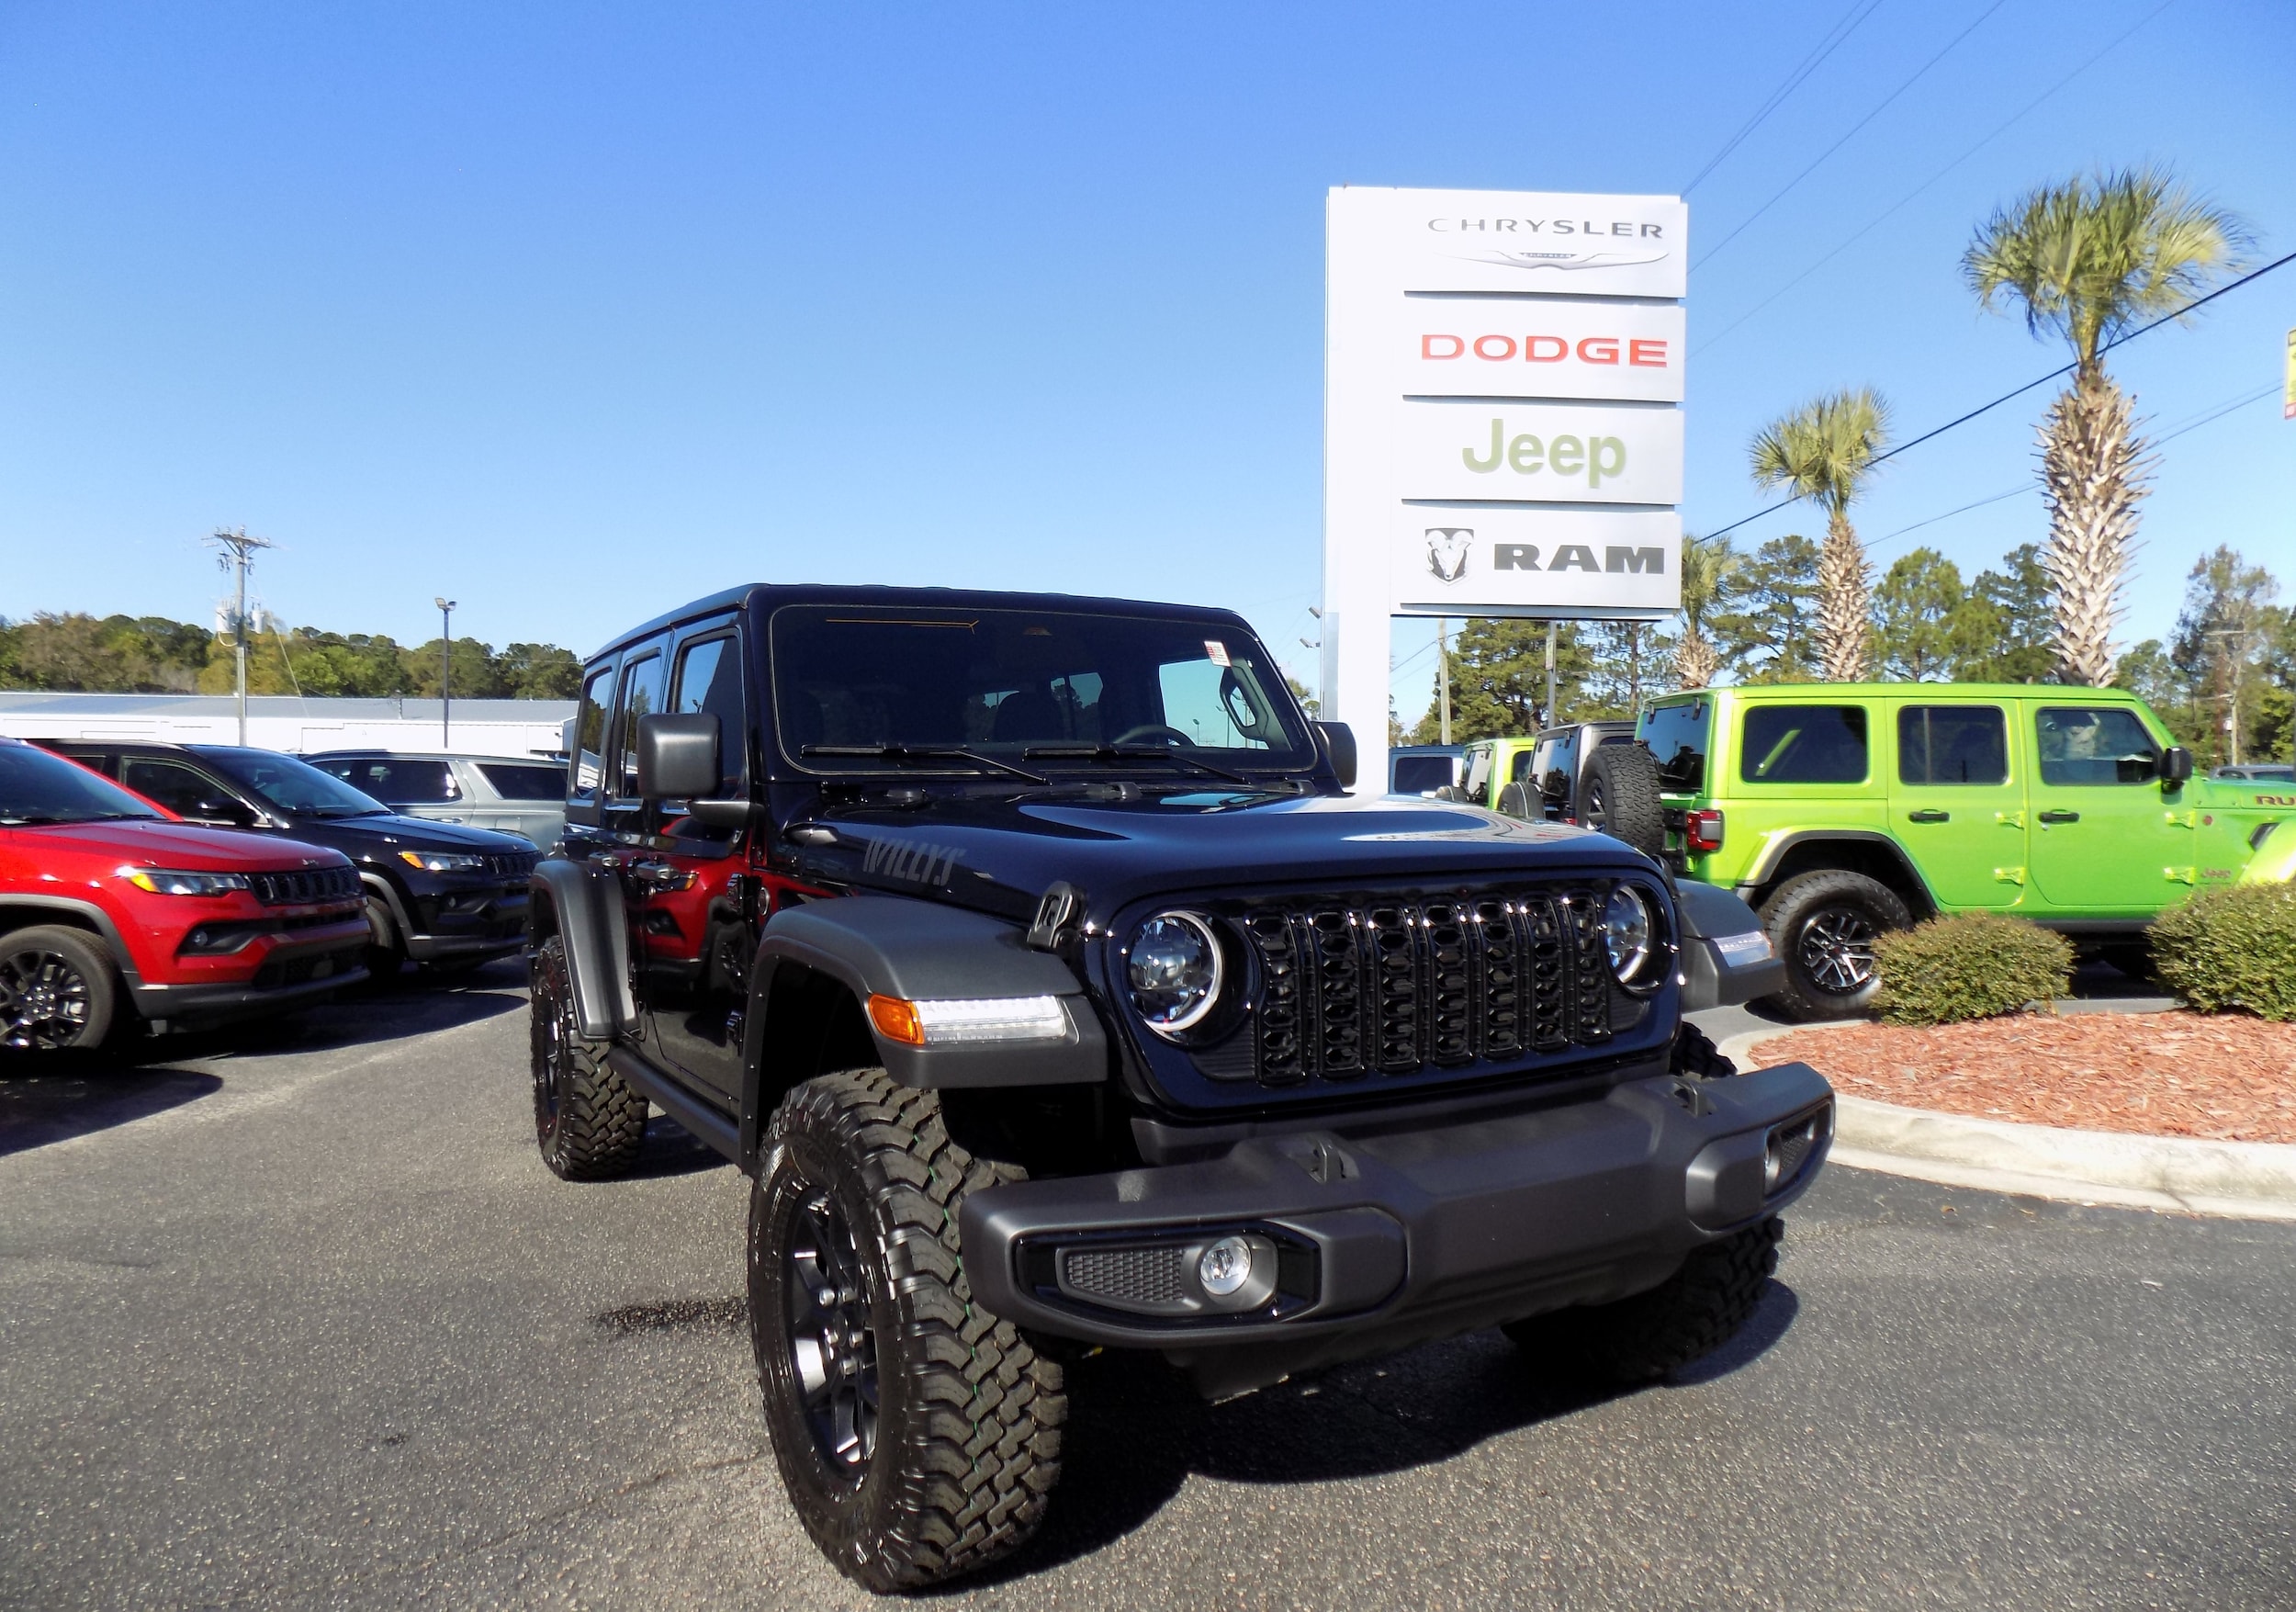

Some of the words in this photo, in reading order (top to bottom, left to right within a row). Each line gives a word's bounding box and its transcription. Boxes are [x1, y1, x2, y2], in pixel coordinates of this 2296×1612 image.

[1428, 219, 1662, 239] CHRYSLER
[1422, 334, 1668, 367] DODGE
[1462, 418, 1626, 489] Jeep
[1493, 543, 1665, 575] RAM
[862, 836, 966, 886] WILLYS
